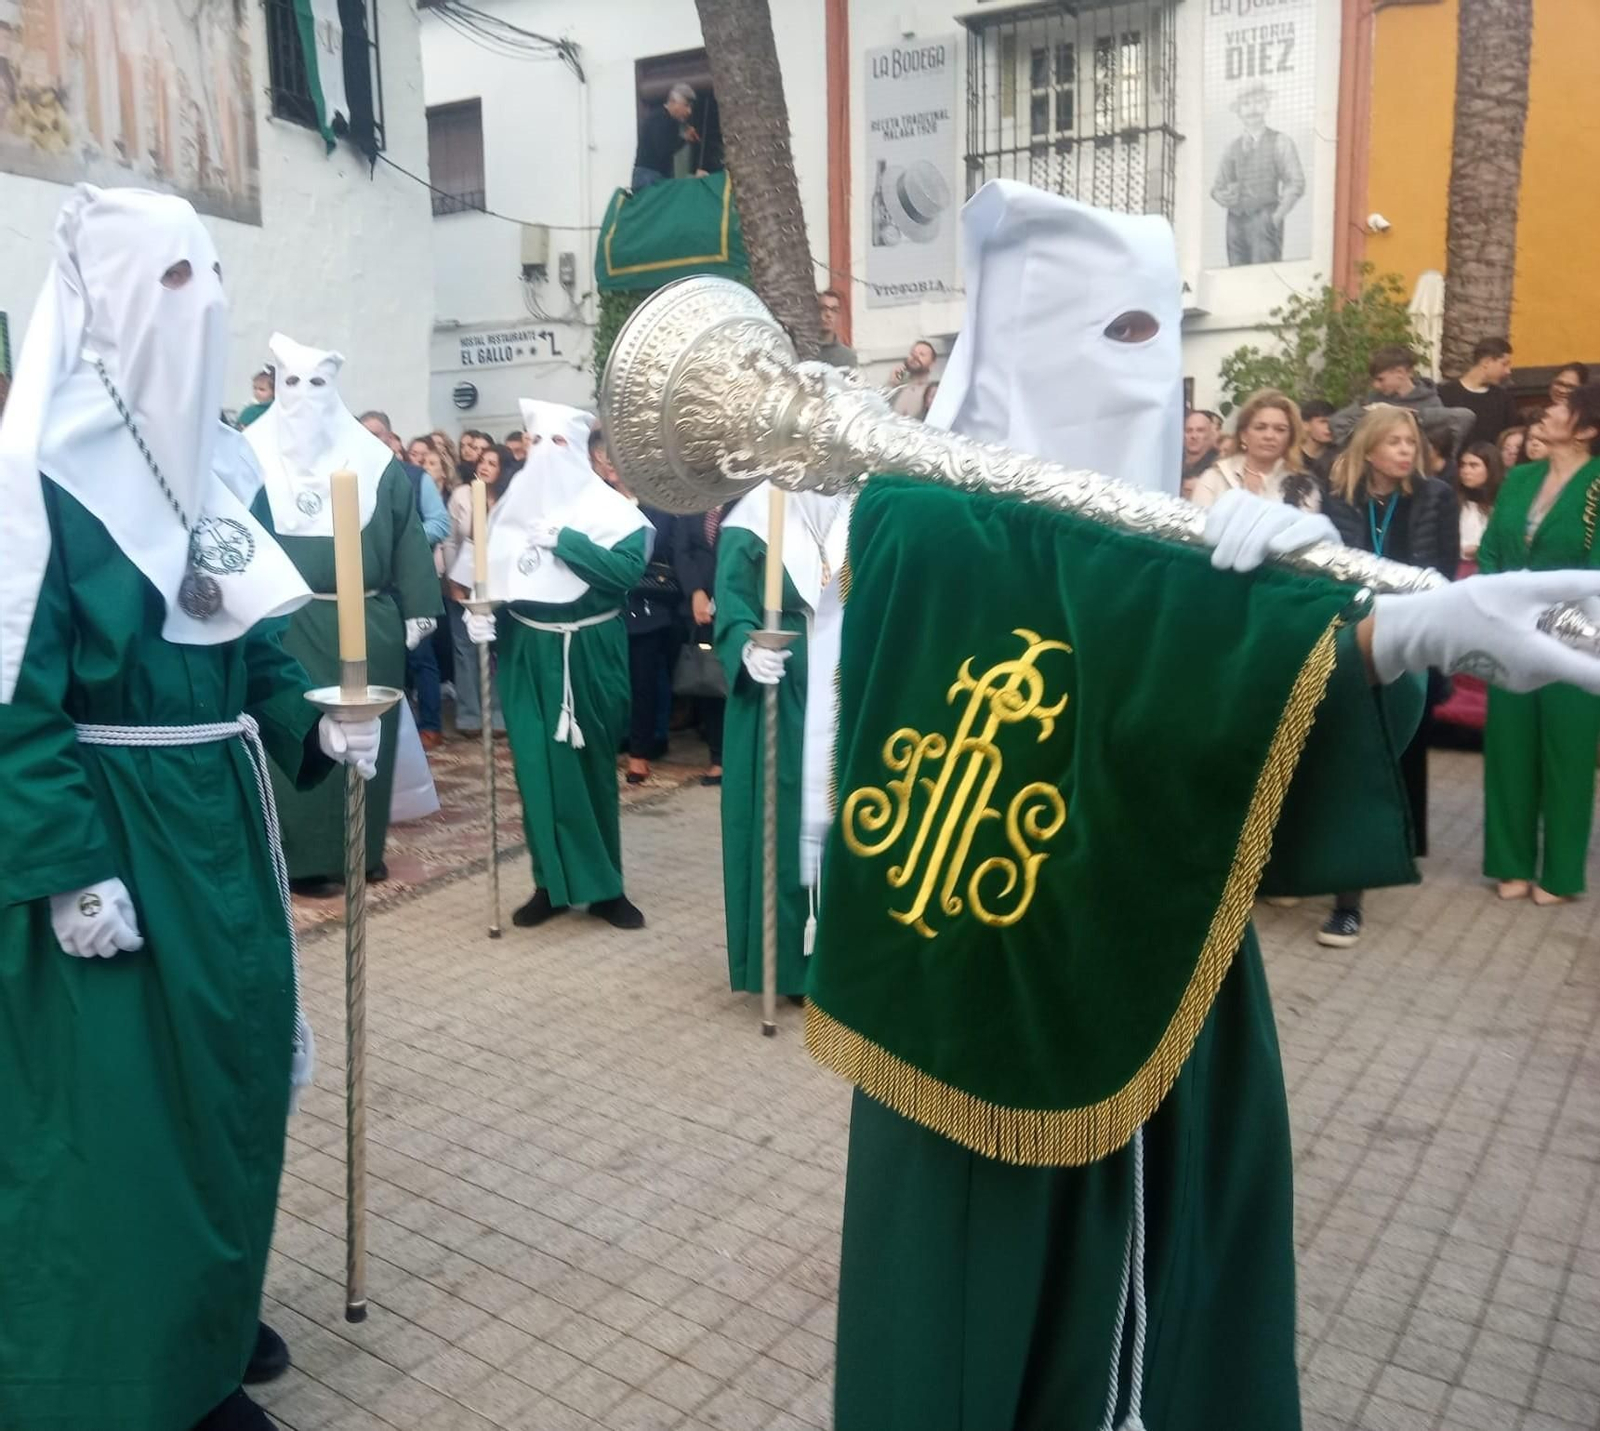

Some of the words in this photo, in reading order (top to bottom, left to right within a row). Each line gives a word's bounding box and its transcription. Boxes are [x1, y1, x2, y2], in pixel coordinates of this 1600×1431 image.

[1225, 22, 1295, 45] VICTORIA
[872, 55, 889, 79] LA
[892, 45, 945, 79] BODEGA
[1225, 38, 1295, 80] DIEZ
[460, 335, 485, 348] HOSTAL
[487, 331, 536, 345] RESTAURANTE
[461, 349, 475, 366] EL
[477, 345, 514, 365] GALLO
